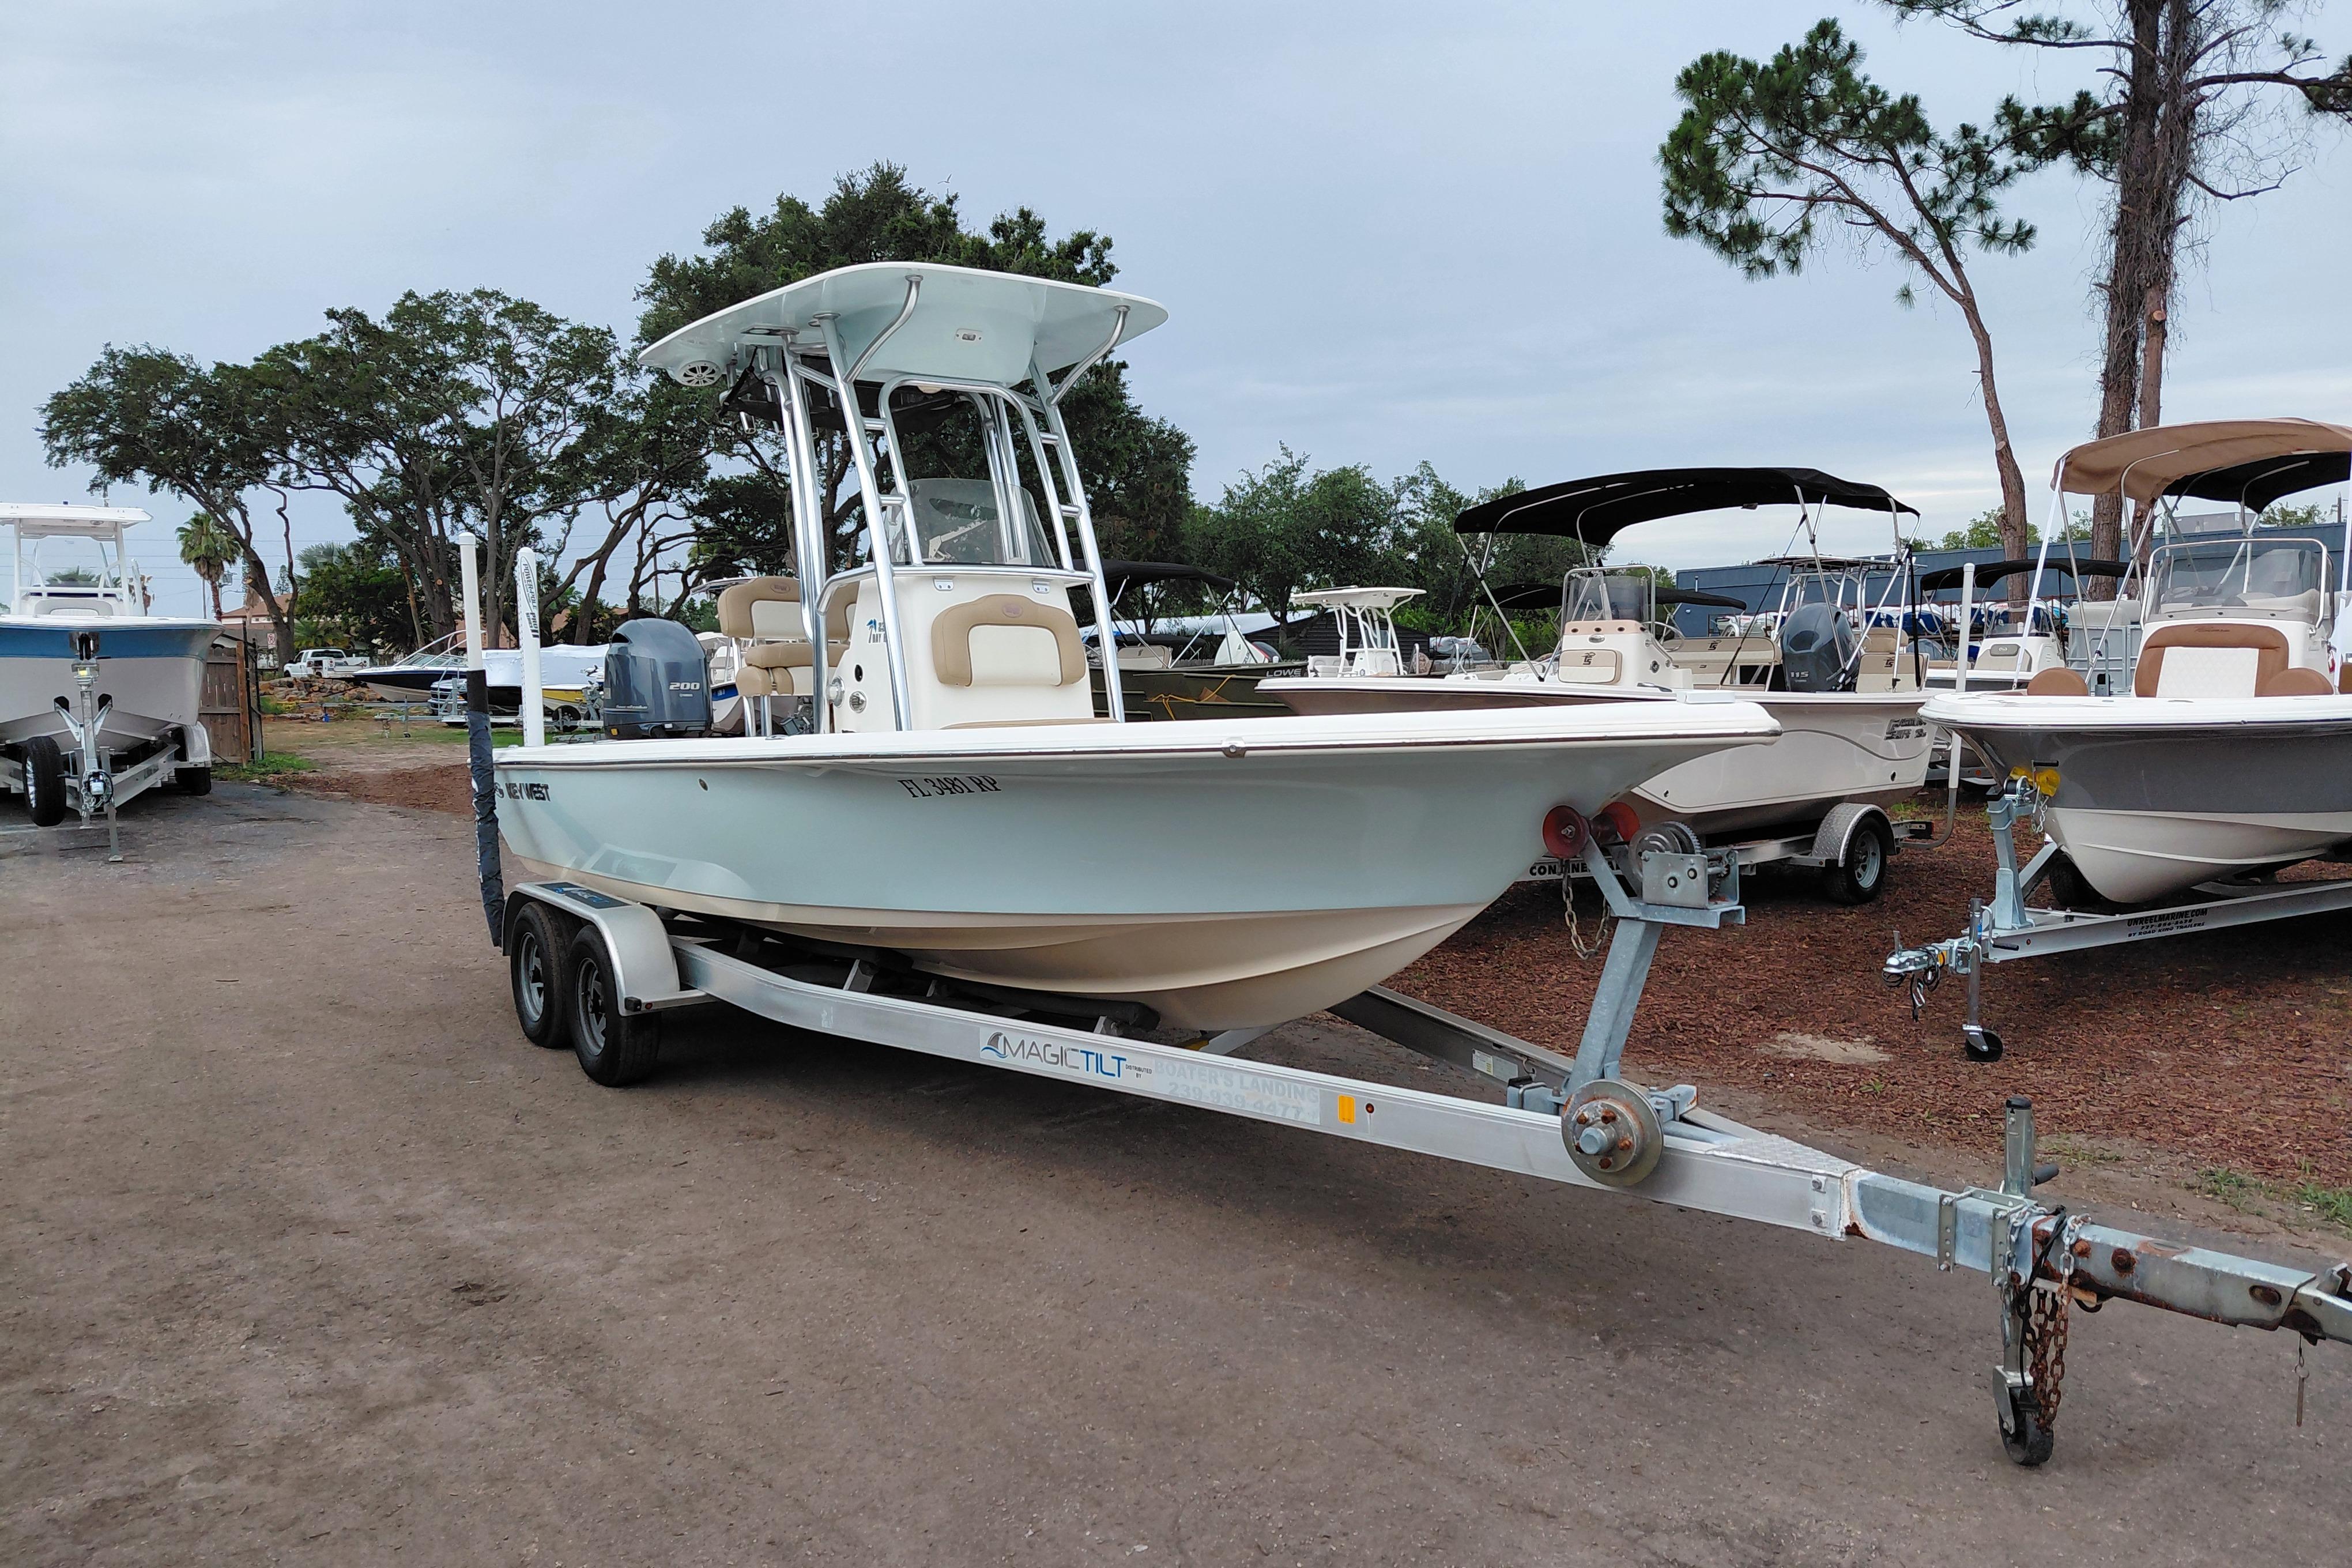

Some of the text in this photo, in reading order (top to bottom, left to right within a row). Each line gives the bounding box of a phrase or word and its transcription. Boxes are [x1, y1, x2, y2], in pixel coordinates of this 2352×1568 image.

[1266, 668, 1302, 677] LOWE
[669, 682, 700, 690] 200
[898, 775, 1002, 797] FL 3481 RP
[1125, 1064, 1152, 1075] DISTRIBUTED
[1239, 1073, 1320, 1103] LANDING
